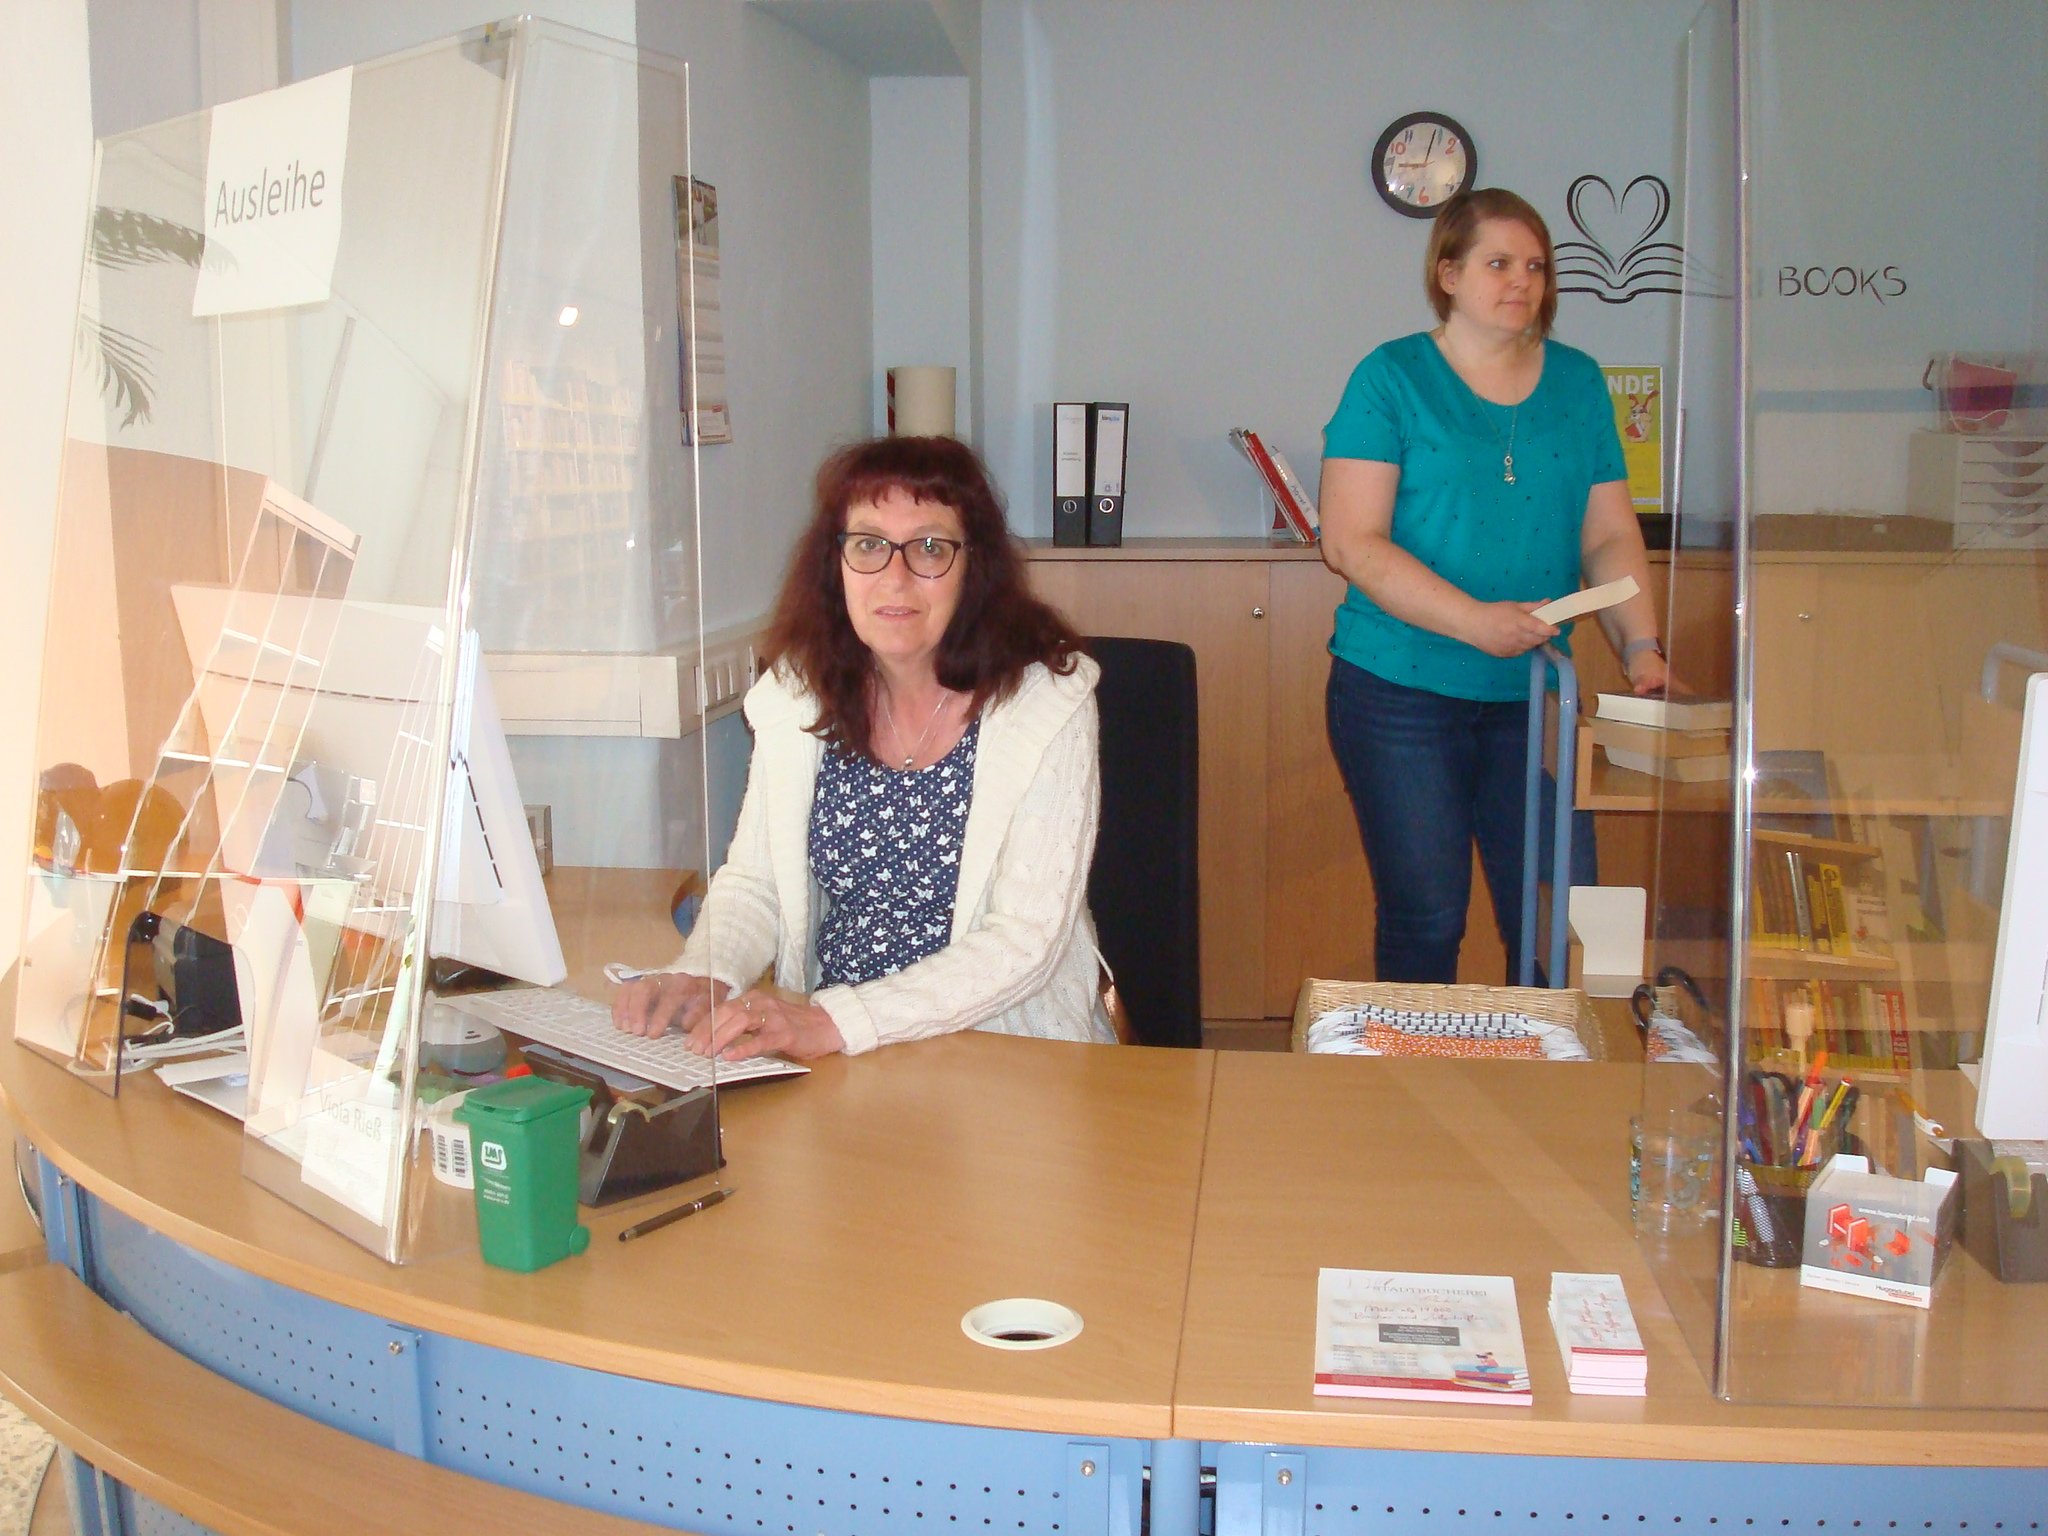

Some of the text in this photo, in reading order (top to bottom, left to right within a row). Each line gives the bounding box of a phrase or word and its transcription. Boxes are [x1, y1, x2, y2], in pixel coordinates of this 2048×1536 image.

[1391, 142, 1406, 155] 10
[1445, 137, 1456, 155] 2
[214, 160, 325, 228] Ausleihe
[1418, 186, 1429, 204] 6
[1778, 265, 1907, 305] BOOKS
[1607, 374, 1656, 395] NDE
